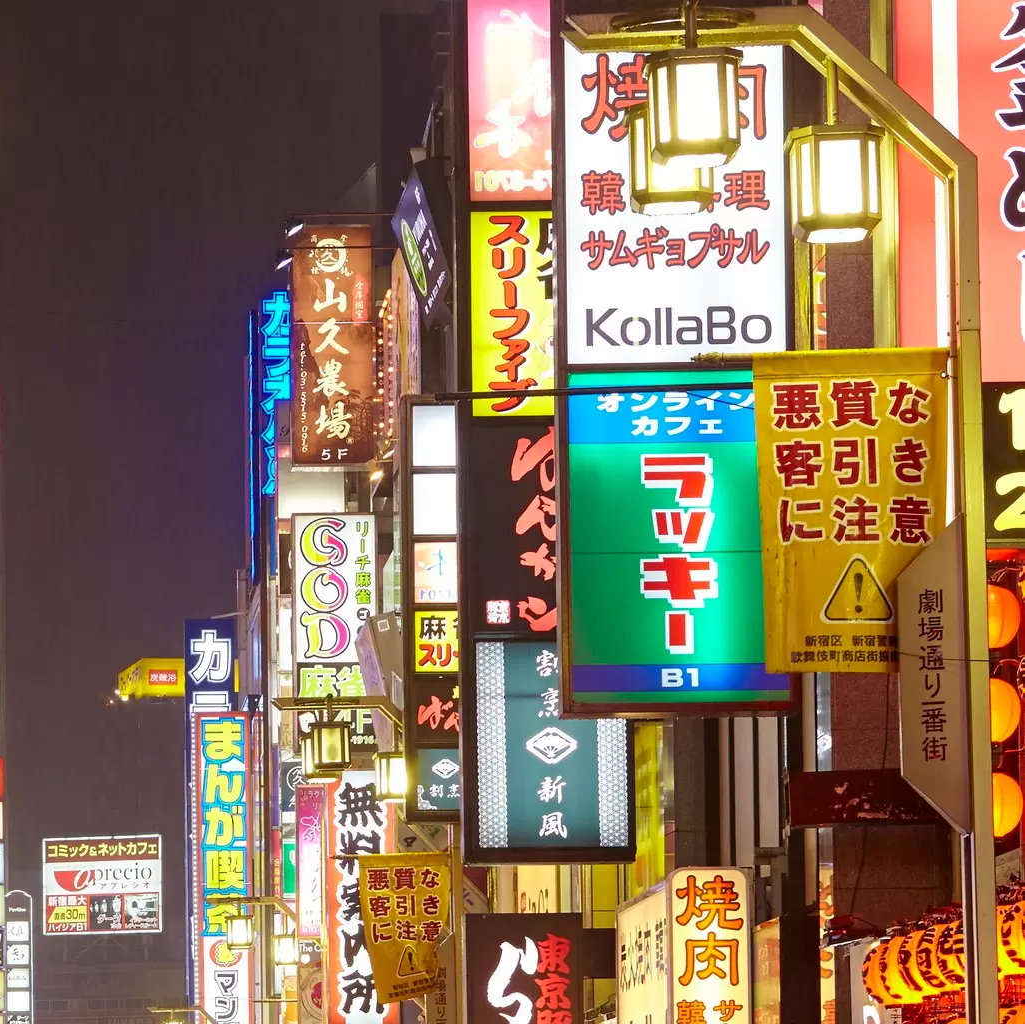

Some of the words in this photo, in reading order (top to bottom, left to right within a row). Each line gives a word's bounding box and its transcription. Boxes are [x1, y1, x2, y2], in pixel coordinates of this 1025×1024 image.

[581, 223, 770, 270] サムギョプサル
[488, 215, 535, 412] スリーファイブ
[585, 306, 773, 347] KollaBo
[312, 278, 352, 440] 山久農場
[597, 391, 755, 412] オンライン
[771, 380, 932, 432] 悪質な
[631, 416, 723, 436] カフェ
[321, 448, 349, 461] 5F
[774, 437, 930, 489] 客引き
[778, 495, 934, 546] に注意
[355, 521, 372, 605] リーチ麻雀
[640, 453, 718, 655] ラッキー
[300, 517, 351, 659] GOD
[805, 635, 843, 647] 新宿区
[661, 668, 700, 687] B1
[917, 588, 948, 762] 劇場通り一番街
[537, 775, 568, 839] 新風
[47, 842, 158, 858] コミック&ネットカフェ
[100, 882, 150, 890] アプレシオ
[366, 867, 441, 892] 悪質な
[47, 896, 88, 907] 新宿最大
[368, 895, 441, 917] 客引き
[47, 923, 88, 932] ハイジアB1
[372, 920, 442, 944] に注意
[675, 875, 744, 987] 焼肉
